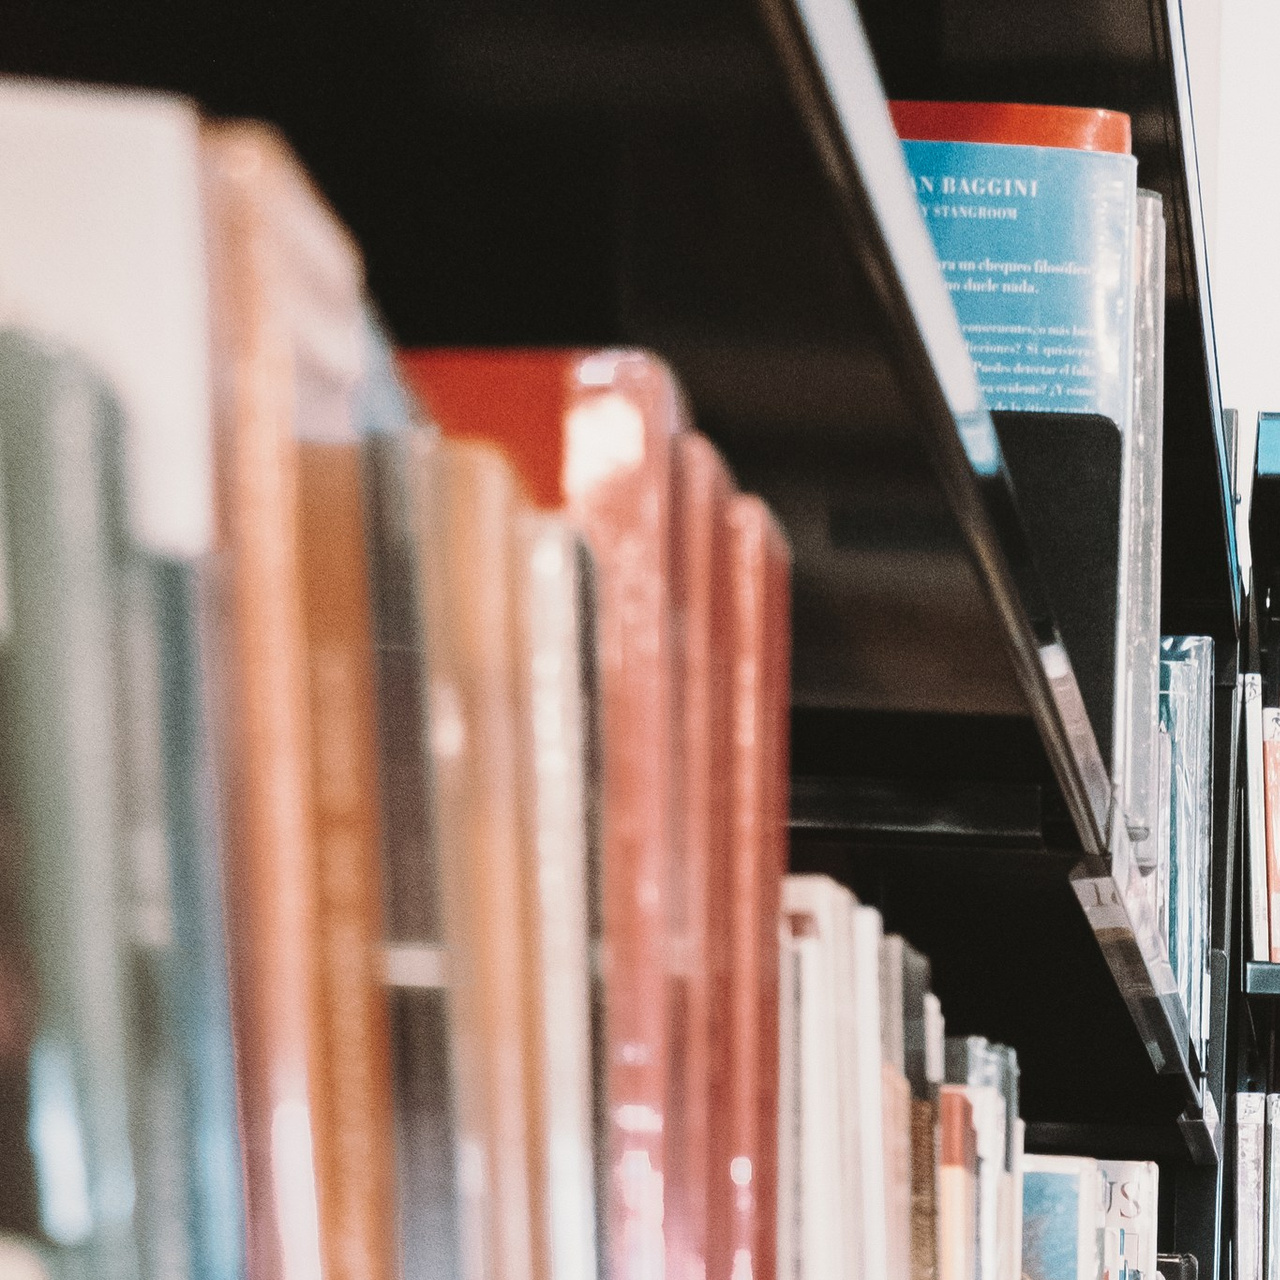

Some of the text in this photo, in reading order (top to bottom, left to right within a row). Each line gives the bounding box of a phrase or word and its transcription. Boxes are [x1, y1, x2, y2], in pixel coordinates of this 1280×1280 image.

[942, 177, 1038, 199] BAGGINI
[933, 205, 1018, 221] STANGROOM
[1002, 278, 1040, 294] nada.
